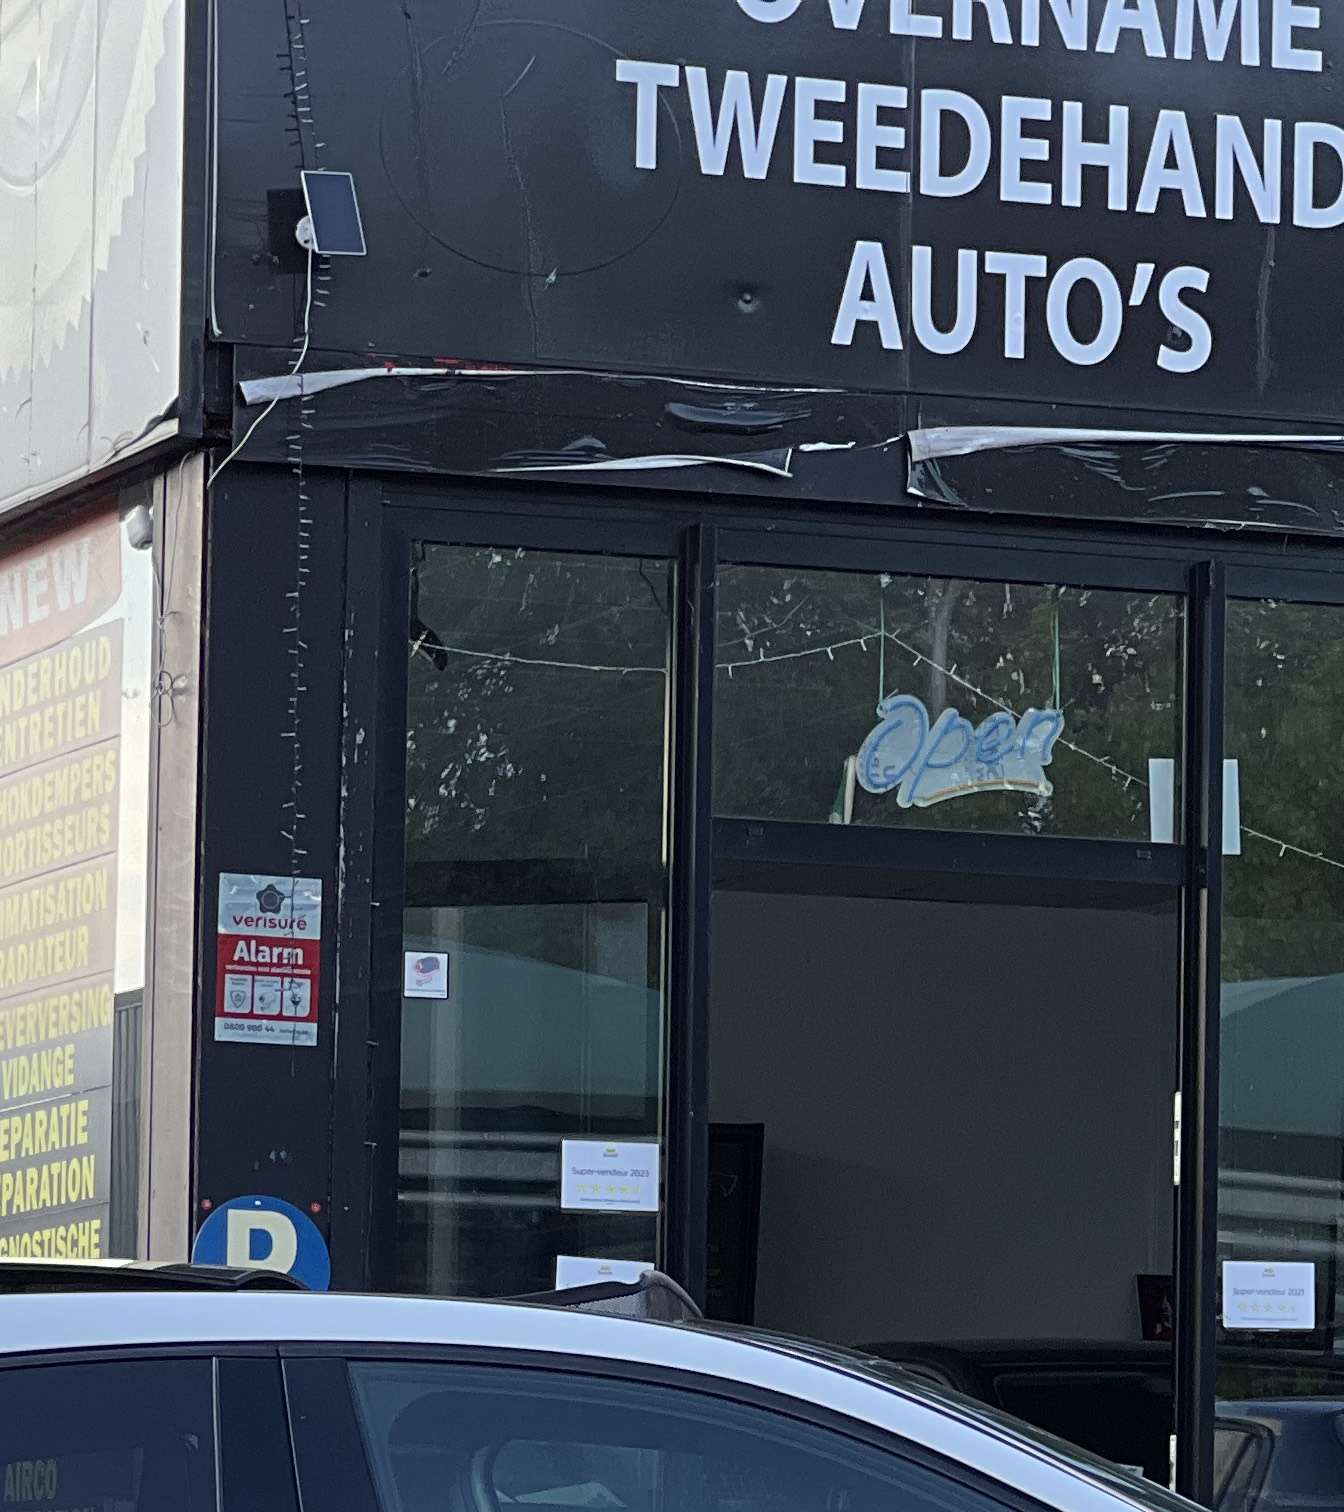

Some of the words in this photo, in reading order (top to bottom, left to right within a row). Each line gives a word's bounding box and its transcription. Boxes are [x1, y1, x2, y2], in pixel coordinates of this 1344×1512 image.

[734, 0, 1324, 72] NAME
[831, 241, 1213, 374] AUTO'S
[865, 699, 1061, 804] Open
[232, 914, 308, 931] verisure
[232, 940, 304, 966] Alarm
[1, 1043, 75, 1100] VIDANGE
[4, 1458, 58, 1502] AIRCO
